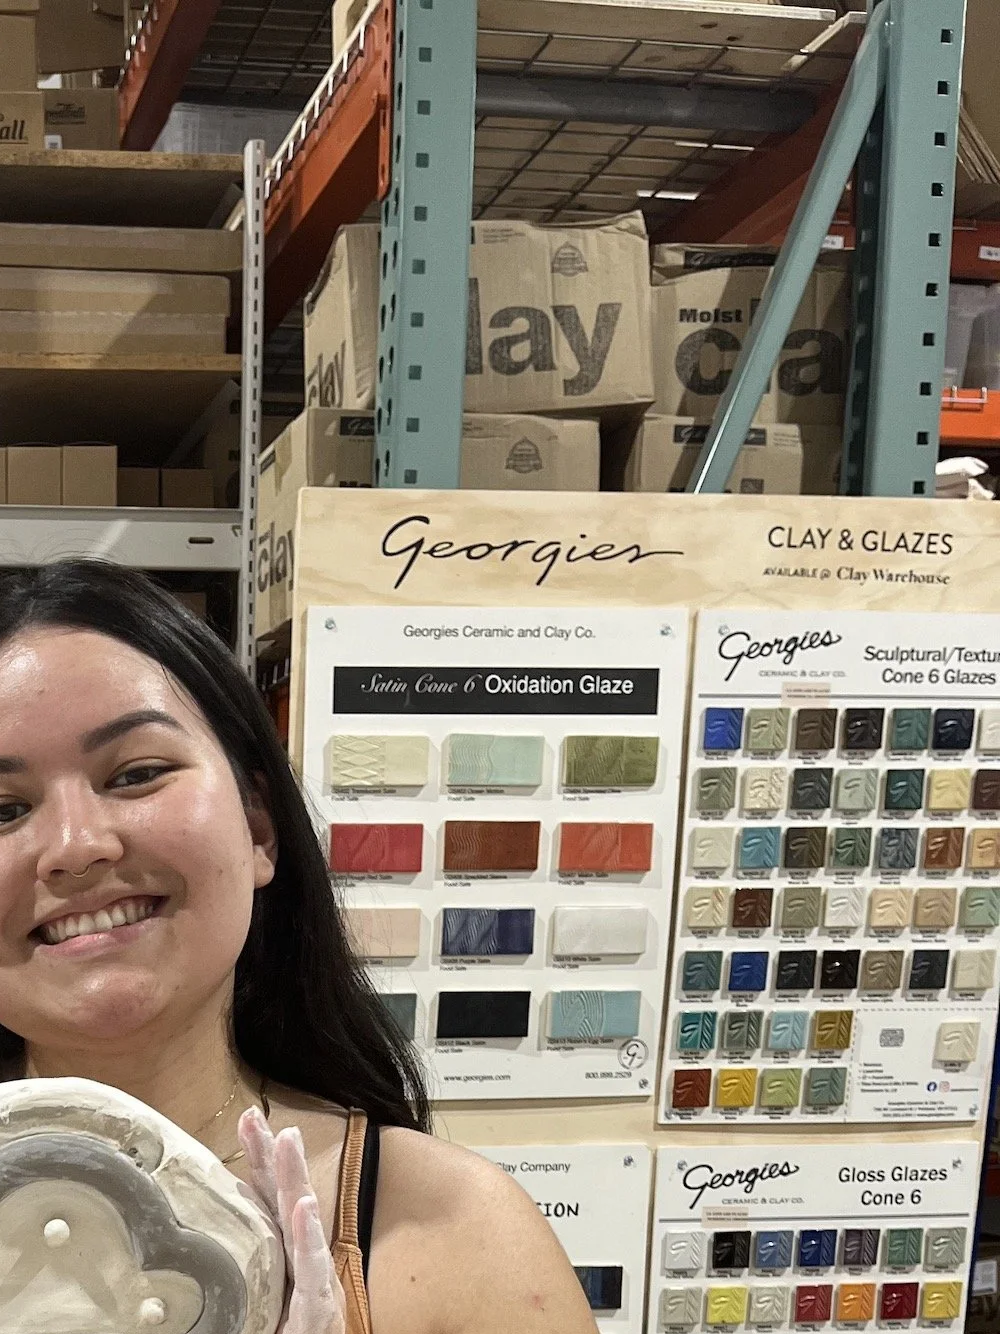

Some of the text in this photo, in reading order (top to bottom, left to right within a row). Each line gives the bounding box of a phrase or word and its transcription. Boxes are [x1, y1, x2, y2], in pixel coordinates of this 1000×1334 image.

[678, 308, 743, 324] Moist
[463, 277, 623, 397] lay
[767, 526, 954, 555] CLAY & GLAZES
[381, 515, 685, 590] Georgies
[762, 567, 818, 579] AVAILABLE
[836, 566, 869, 585] Clay
[872, 568, 950, 585] Warehouse
[402, 625, 597, 641] Georgies Ceramic and Clay Co.
[718, 630, 843, 682] Georgies
[360, 672, 634, 700] Satin Cone 6 Oxidation Glaze
[881, 668, 997, 686] Cone 6 Glazes
[519, 1161, 571, 1174] Company
[838, 1166, 948, 1183] Gloss Glazes
[682, 1161, 801, 1210] Georgies
[861, 1189, 922, 1206] Cone 6
